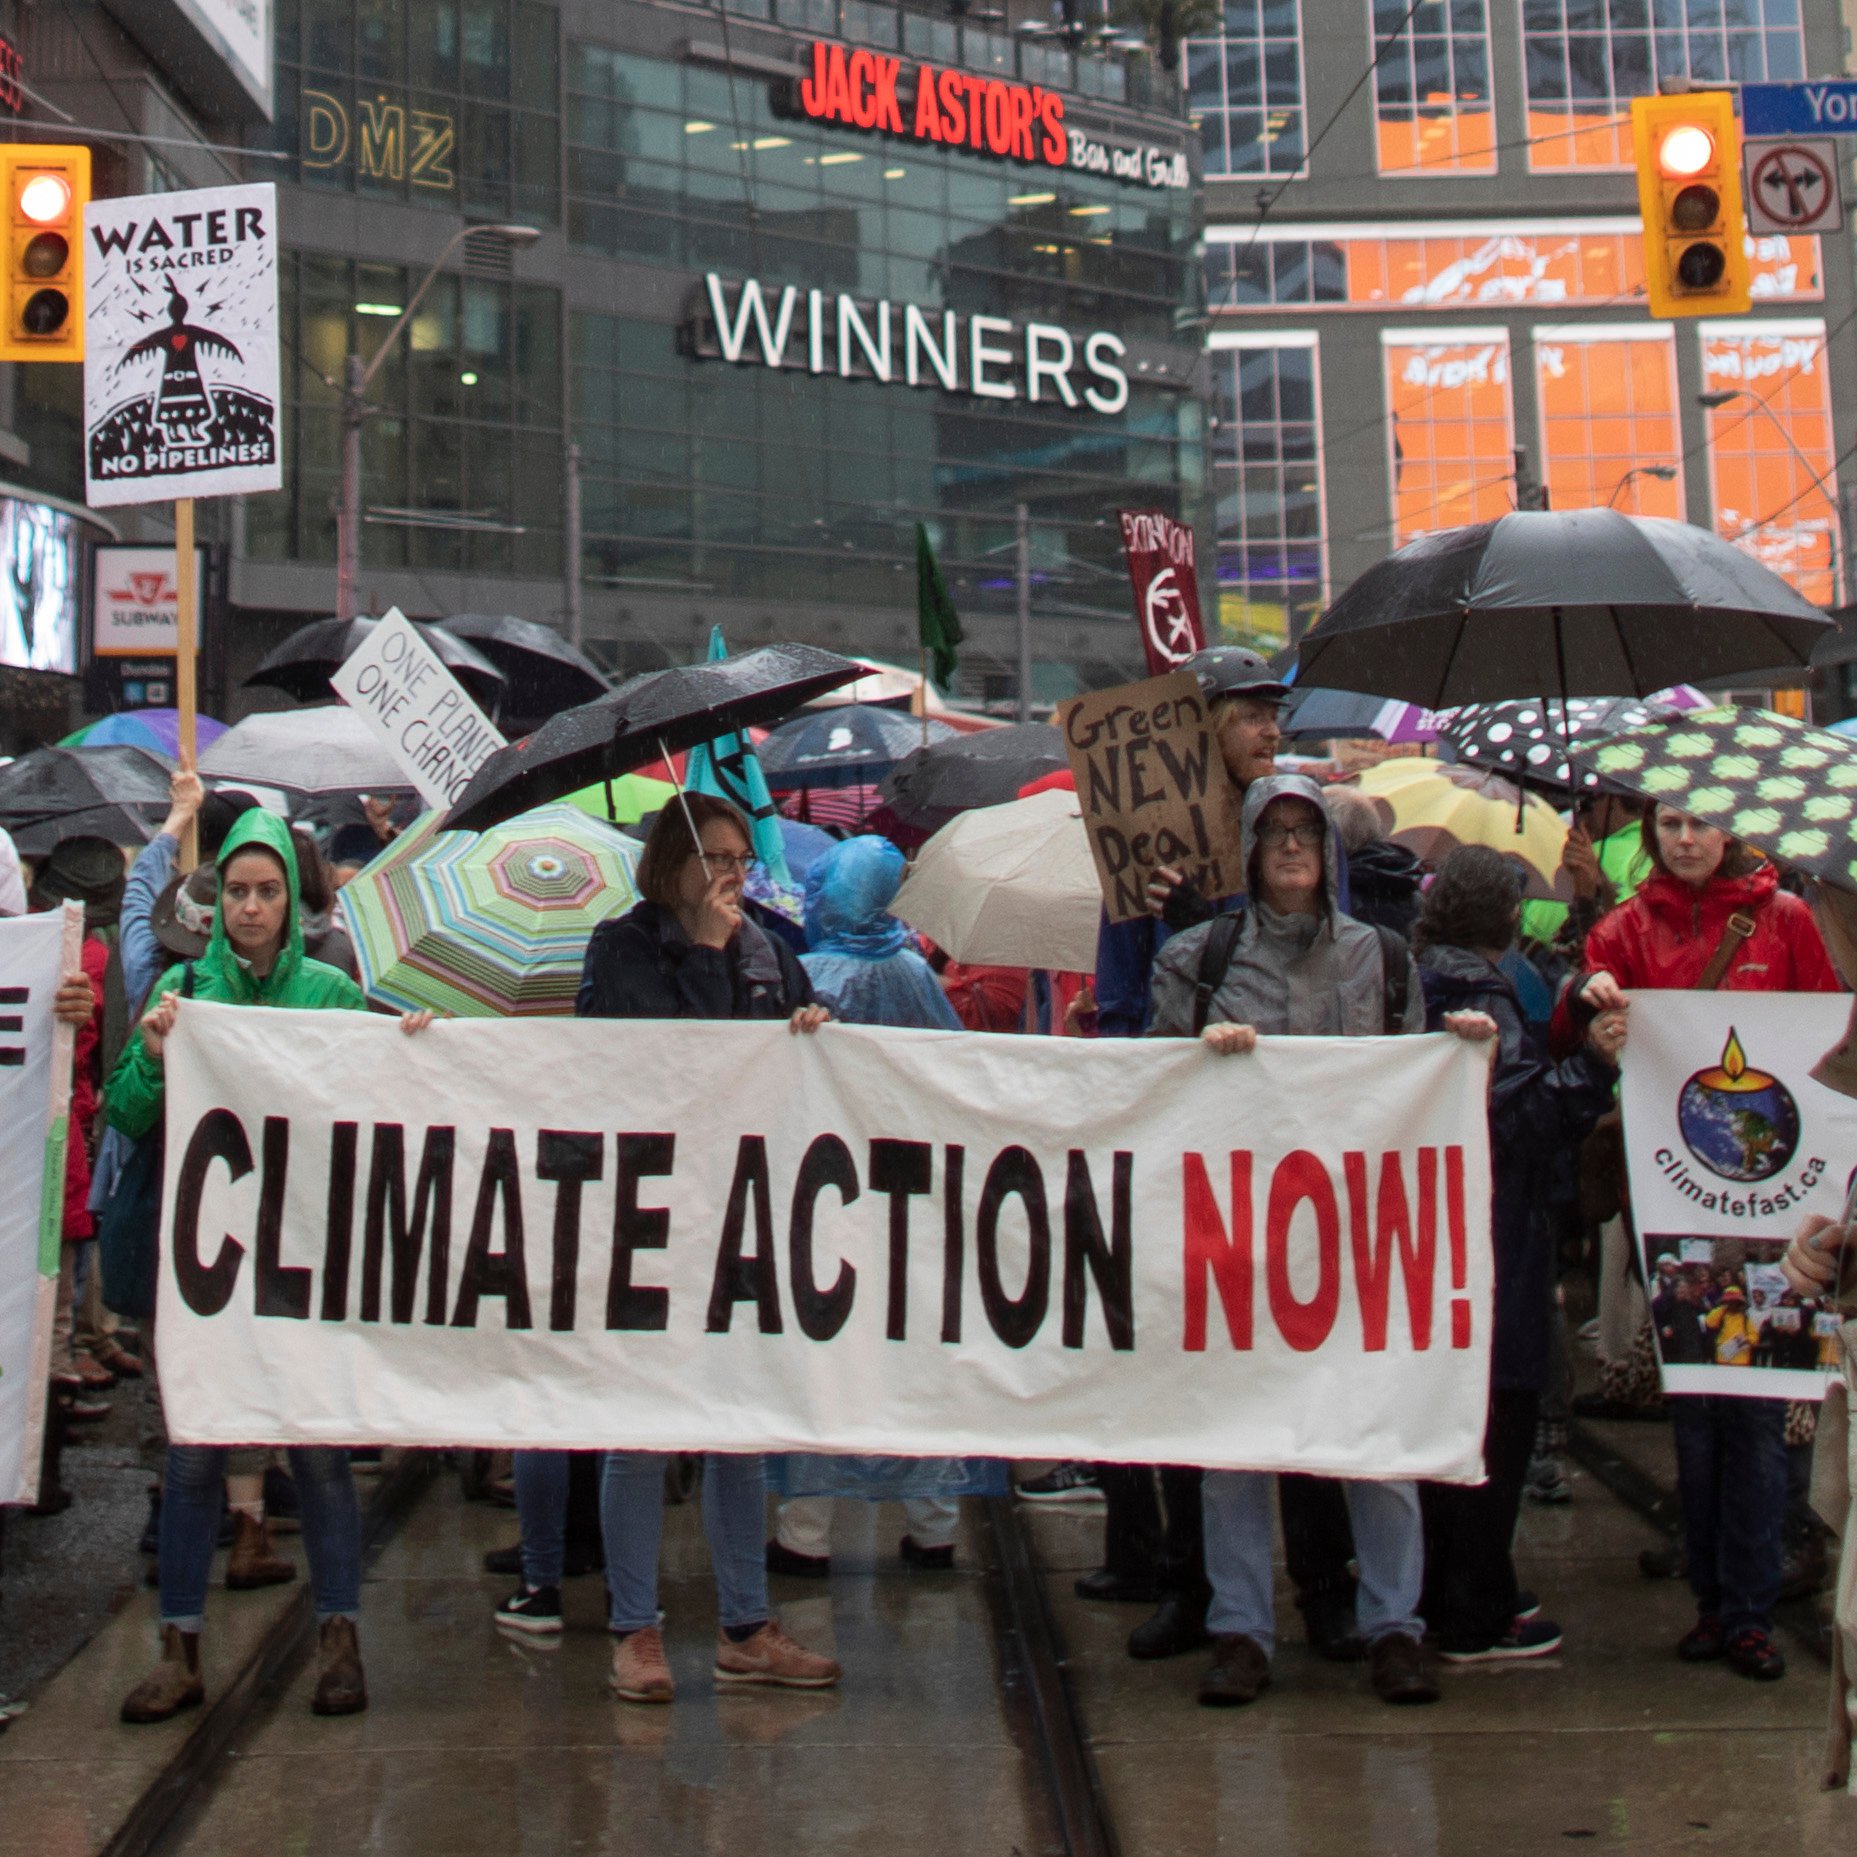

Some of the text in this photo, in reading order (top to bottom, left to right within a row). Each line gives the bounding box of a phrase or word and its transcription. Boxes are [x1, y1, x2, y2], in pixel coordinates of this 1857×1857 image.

[301, 89, 454, 190] DMZ
[801, 40, 904, 134] JACK
[914, 63, 1068, 167] ASTOR'S
[90, 206, 266, 259] WATER
[126, 247, 234, 275] IS SACRED
[705, 271, 1131, 415] WINNERS
[100, 441, 270, 476] NO PIPELINES!
[356, 664, 410, 729] ONE
[381, 631, 438, 700] ONE
[1066, 695, 1203, 750] Green
[1087, 730, 1210, 817] NEW
[1097, 802, 1211, 876] Deal
[1653, 1146, 1827, 1219] climatefast.ca
[170, 1107, 676, 1333] CLIMATE
[705, 1132, 1135, 1352] ACTION
[1180, 1143, 1474, 1354] NOW!
